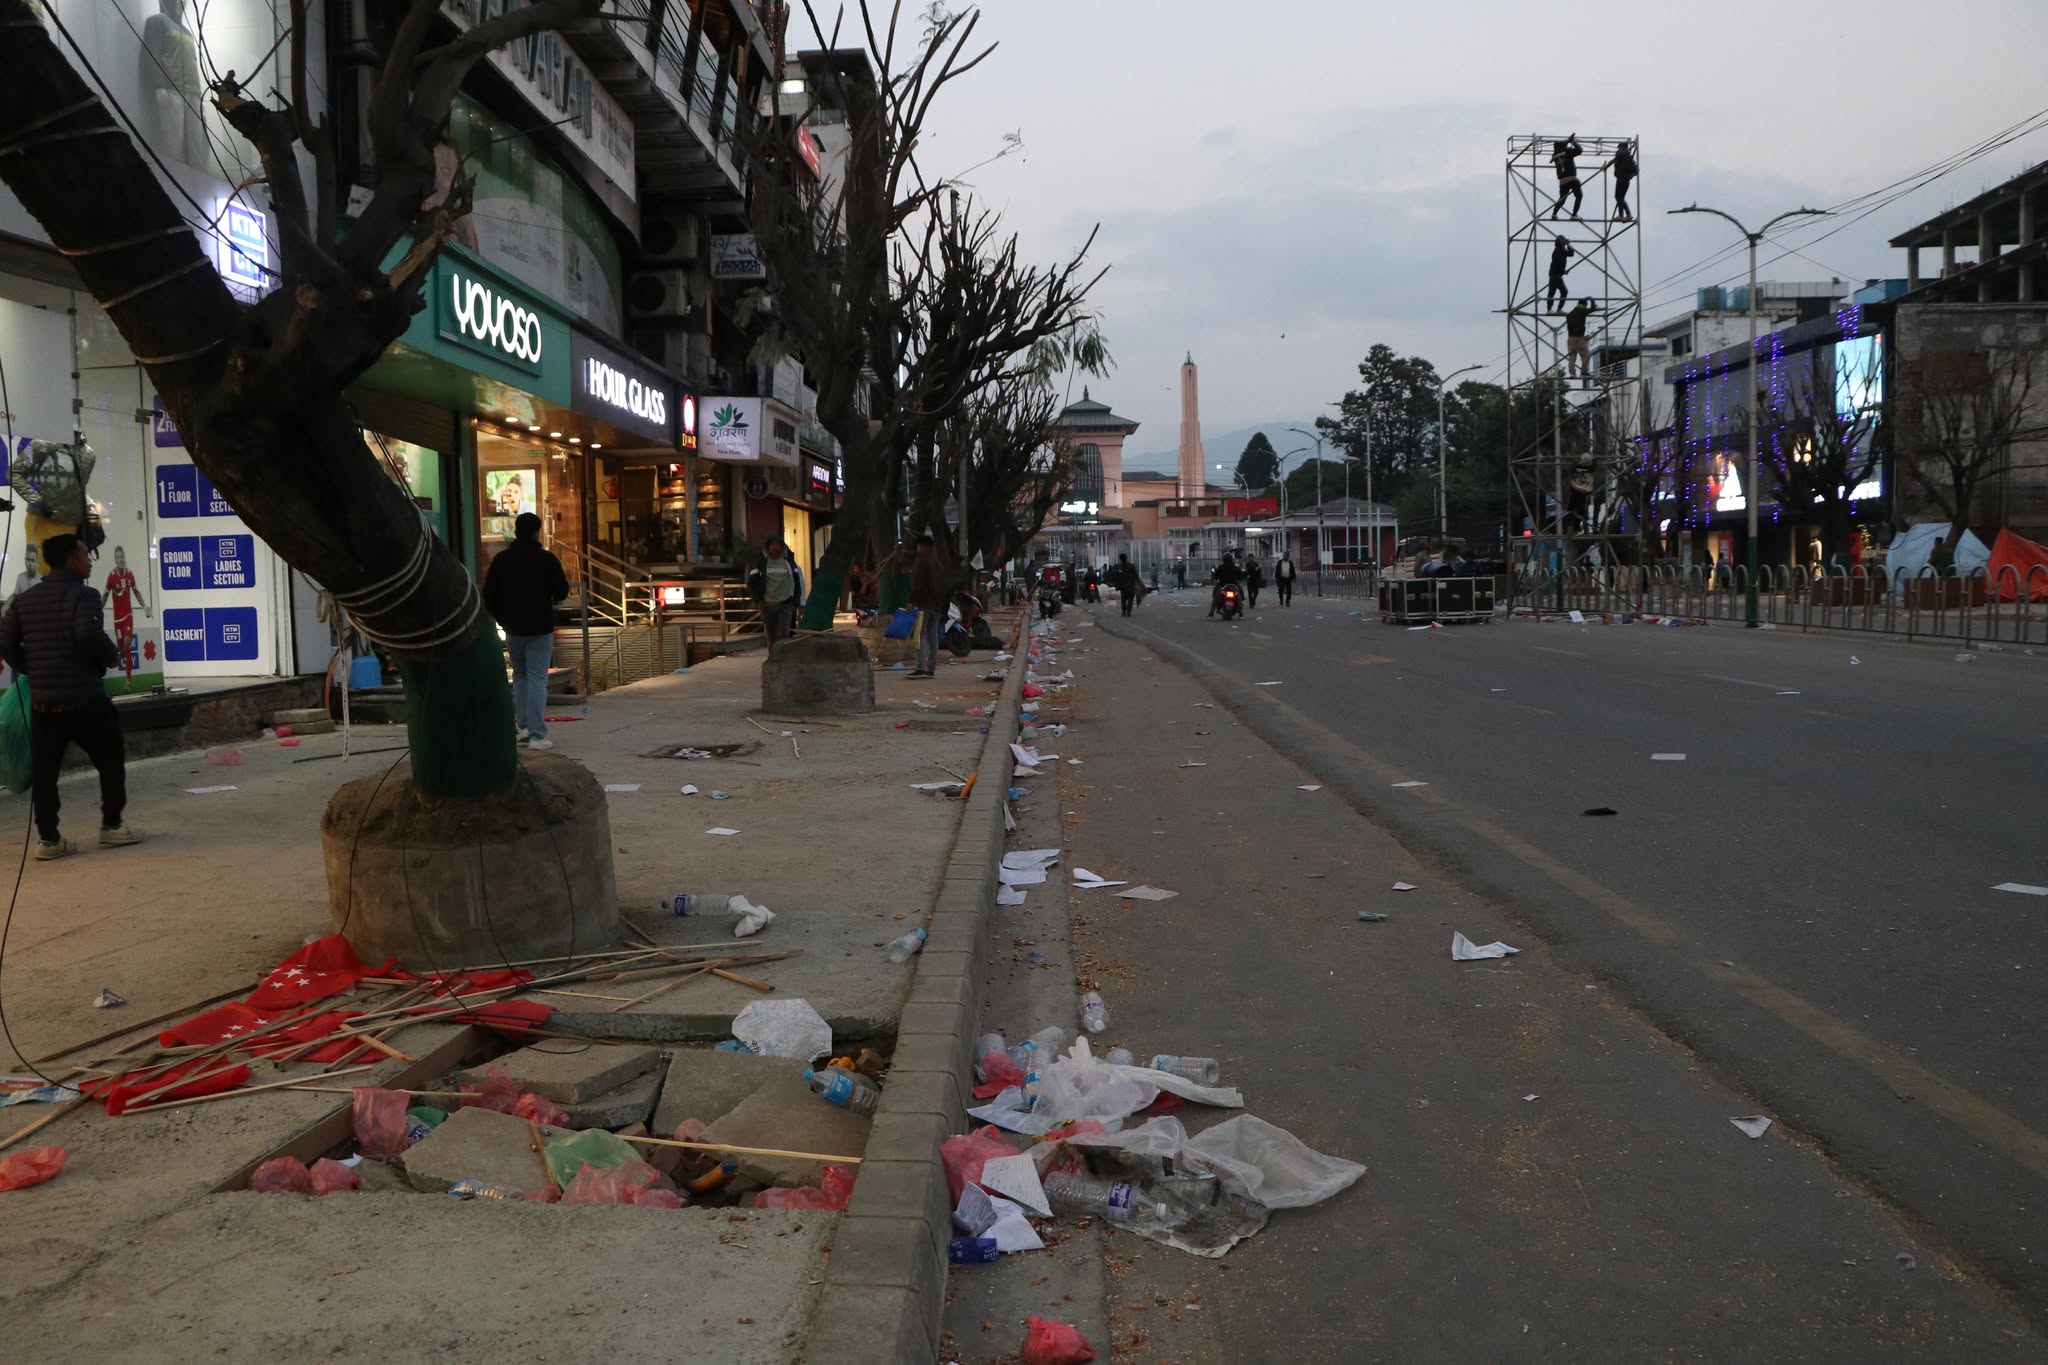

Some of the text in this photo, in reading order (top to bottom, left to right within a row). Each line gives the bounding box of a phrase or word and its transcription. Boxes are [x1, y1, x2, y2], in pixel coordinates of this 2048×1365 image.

[231, 211, 261, 241] KTM
[234, 250, 262, 275] CTY
[453, 273, 542, 364] YOYOSO
[589, 357, 666, 425] HOUR GLASS
[812, 465, 830, 483] ARROW
[159, 480, 175, 503] 1 ST
[168, 490, 192, 503] FLOOR
[209, 501, 236, 513] SECTI
[163, 551, 194, 563] GROUND
[168, 565, 192, 578] FLOOR
[215, 560, 242, 572] LADIES
[213, 573, 245, 585] SECTION
[165, 629, 204, 641] BASEMENT
